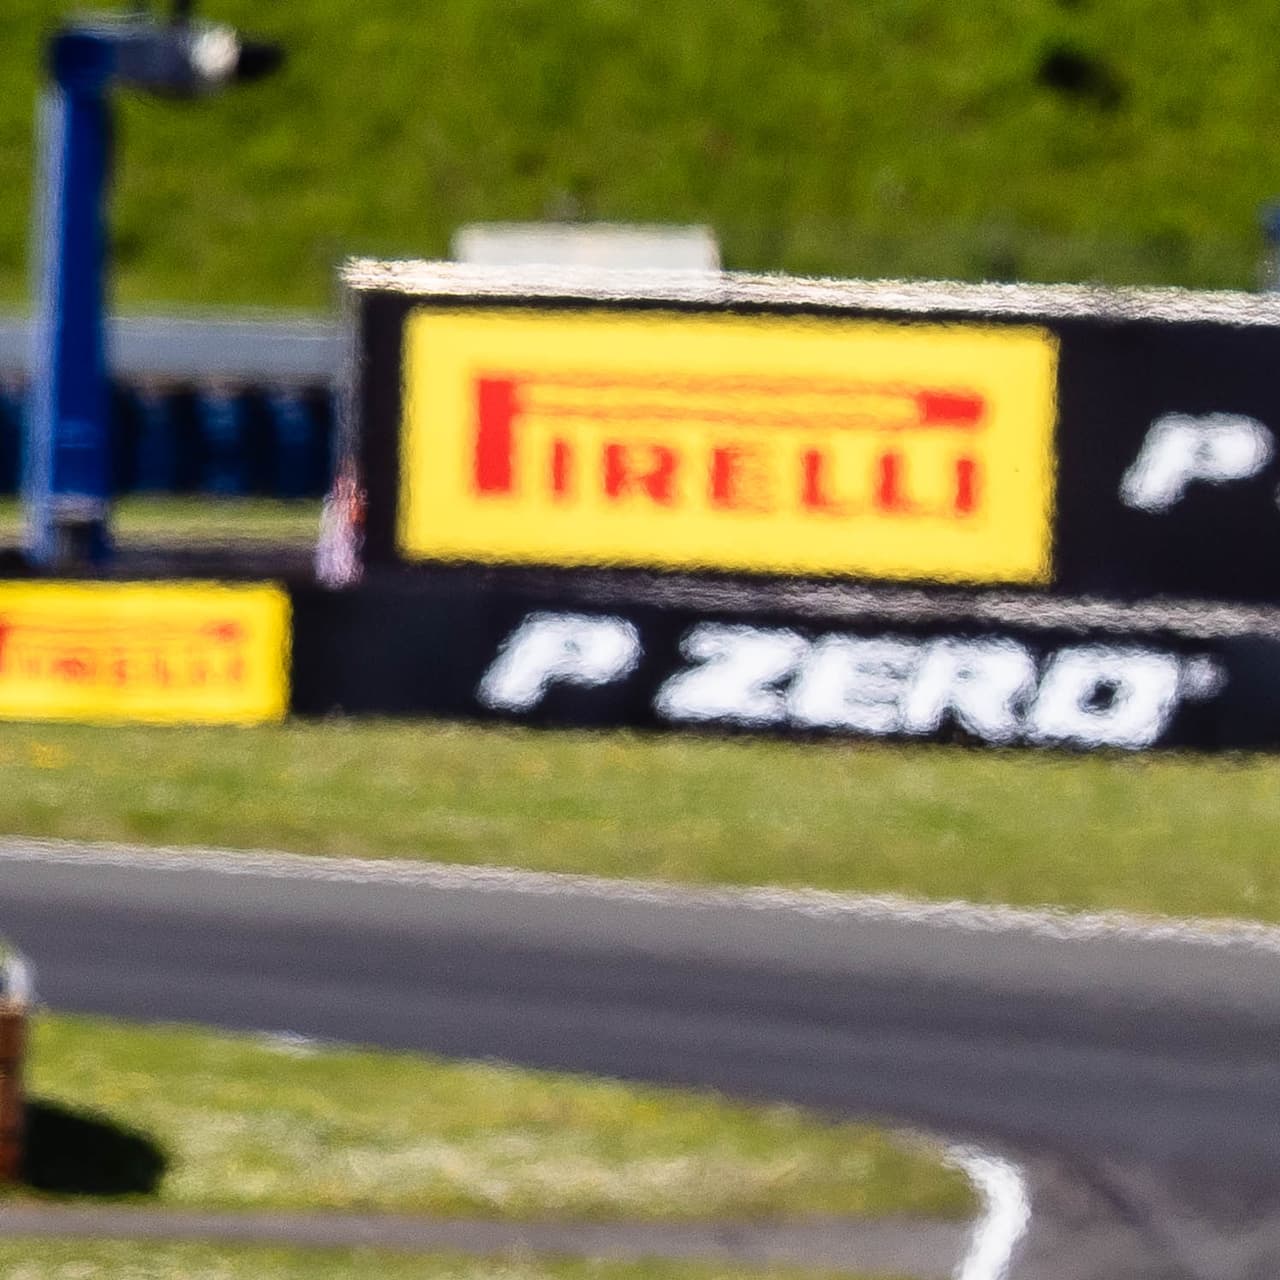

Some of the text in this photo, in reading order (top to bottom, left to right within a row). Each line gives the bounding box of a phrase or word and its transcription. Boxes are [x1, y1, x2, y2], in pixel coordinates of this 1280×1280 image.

[470, 370, 985, 517] PIRELLI
[1122, 412, 1273, 512] P
[476, 611, 1190, 748] P ZERO
